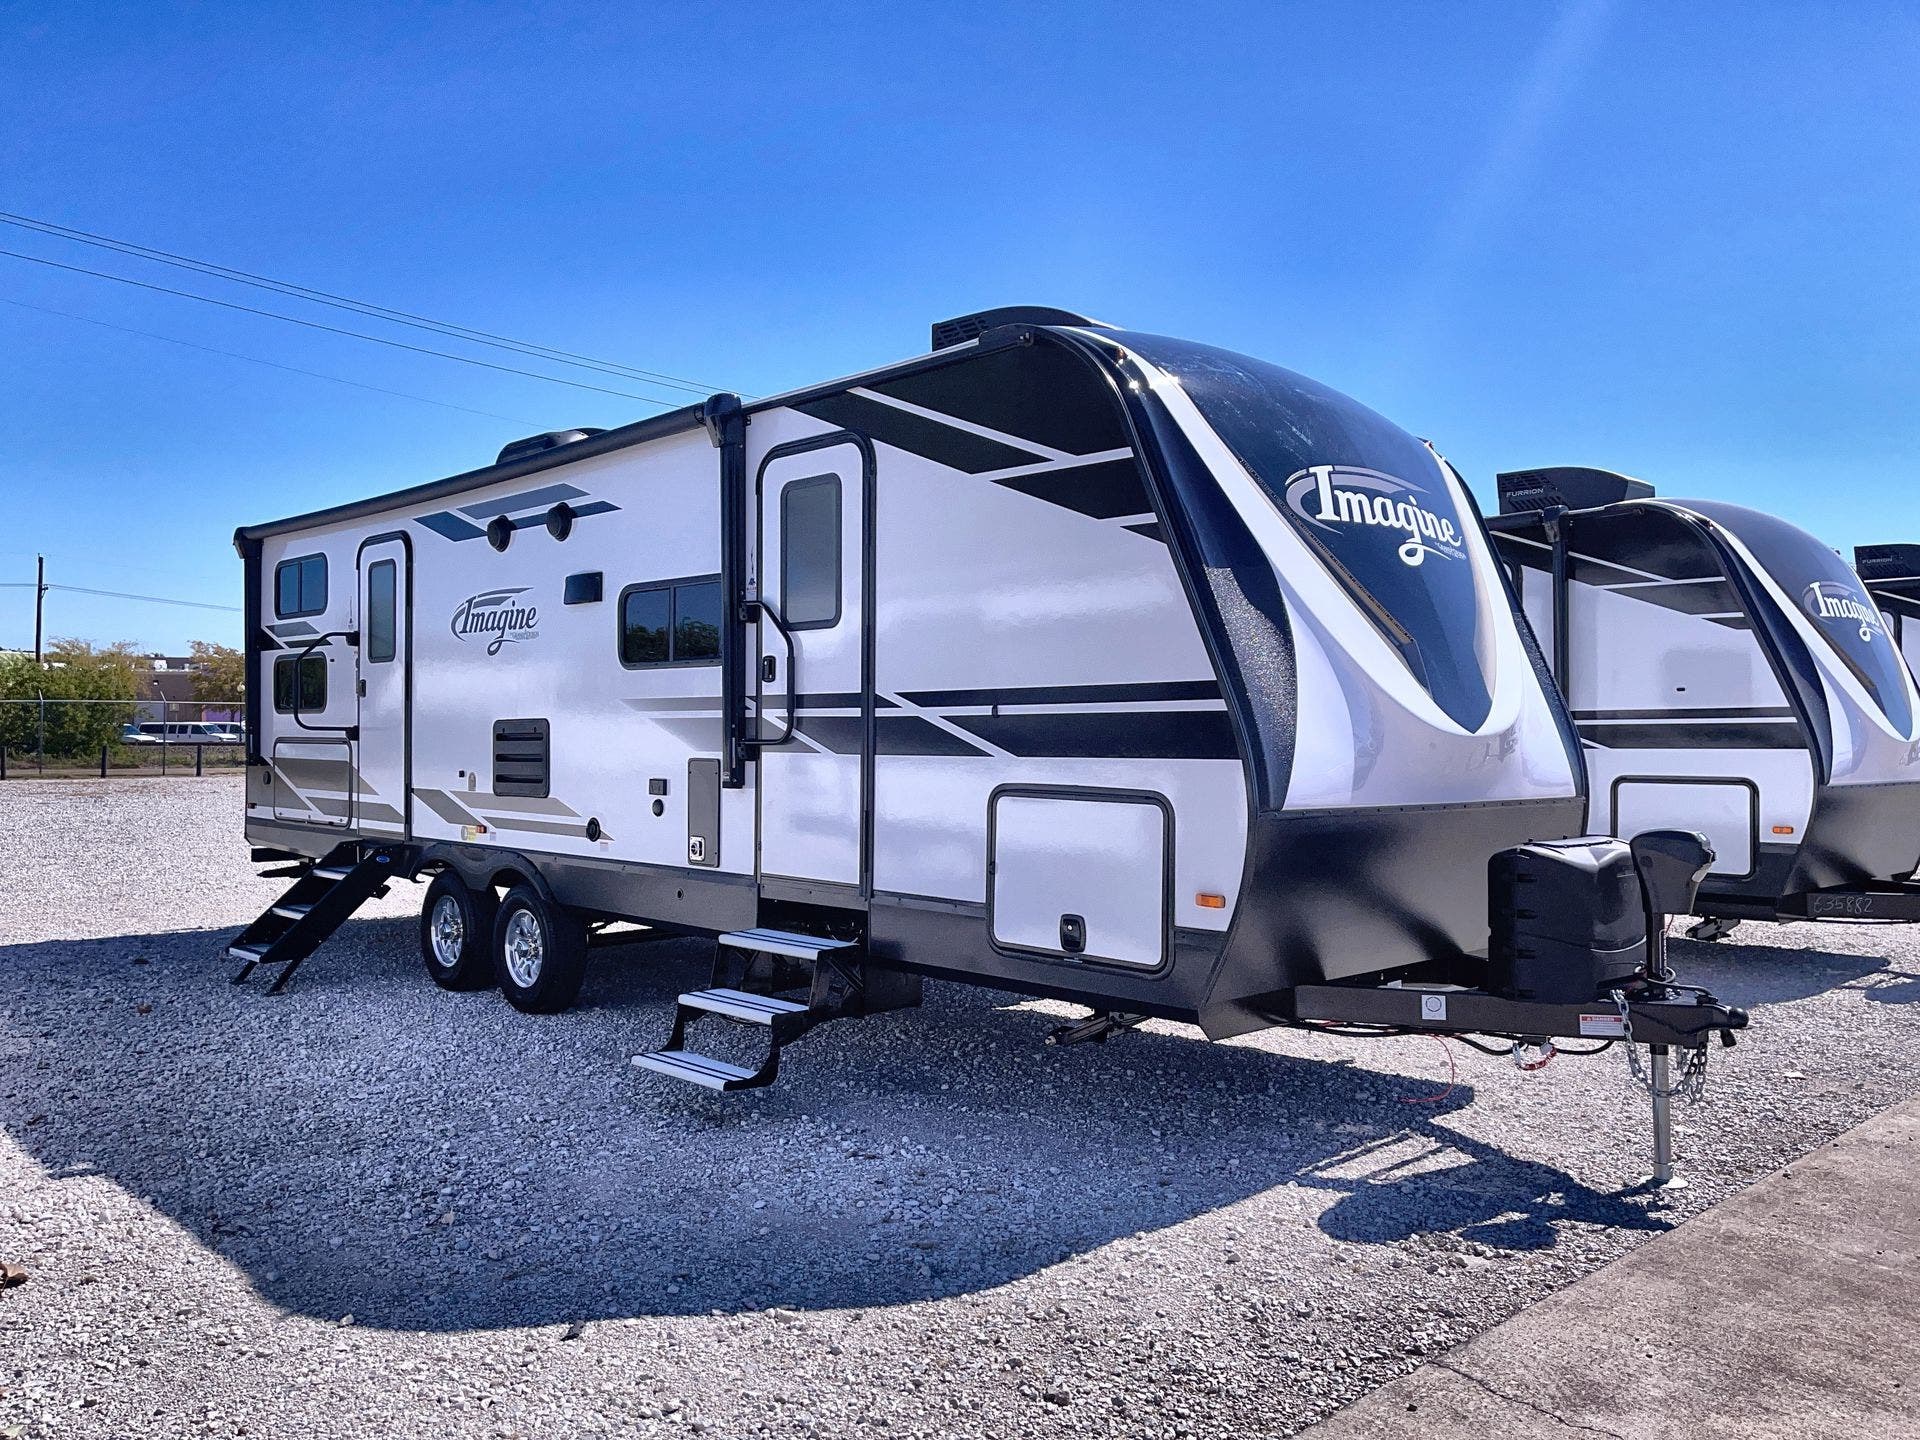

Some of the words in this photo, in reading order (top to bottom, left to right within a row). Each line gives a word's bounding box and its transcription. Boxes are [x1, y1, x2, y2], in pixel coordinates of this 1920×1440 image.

[1309, 465, 1462, 566] Imagine
[1505, 488, 1544, 498] FURRION
[458, 595, 540, 657] Imagine
